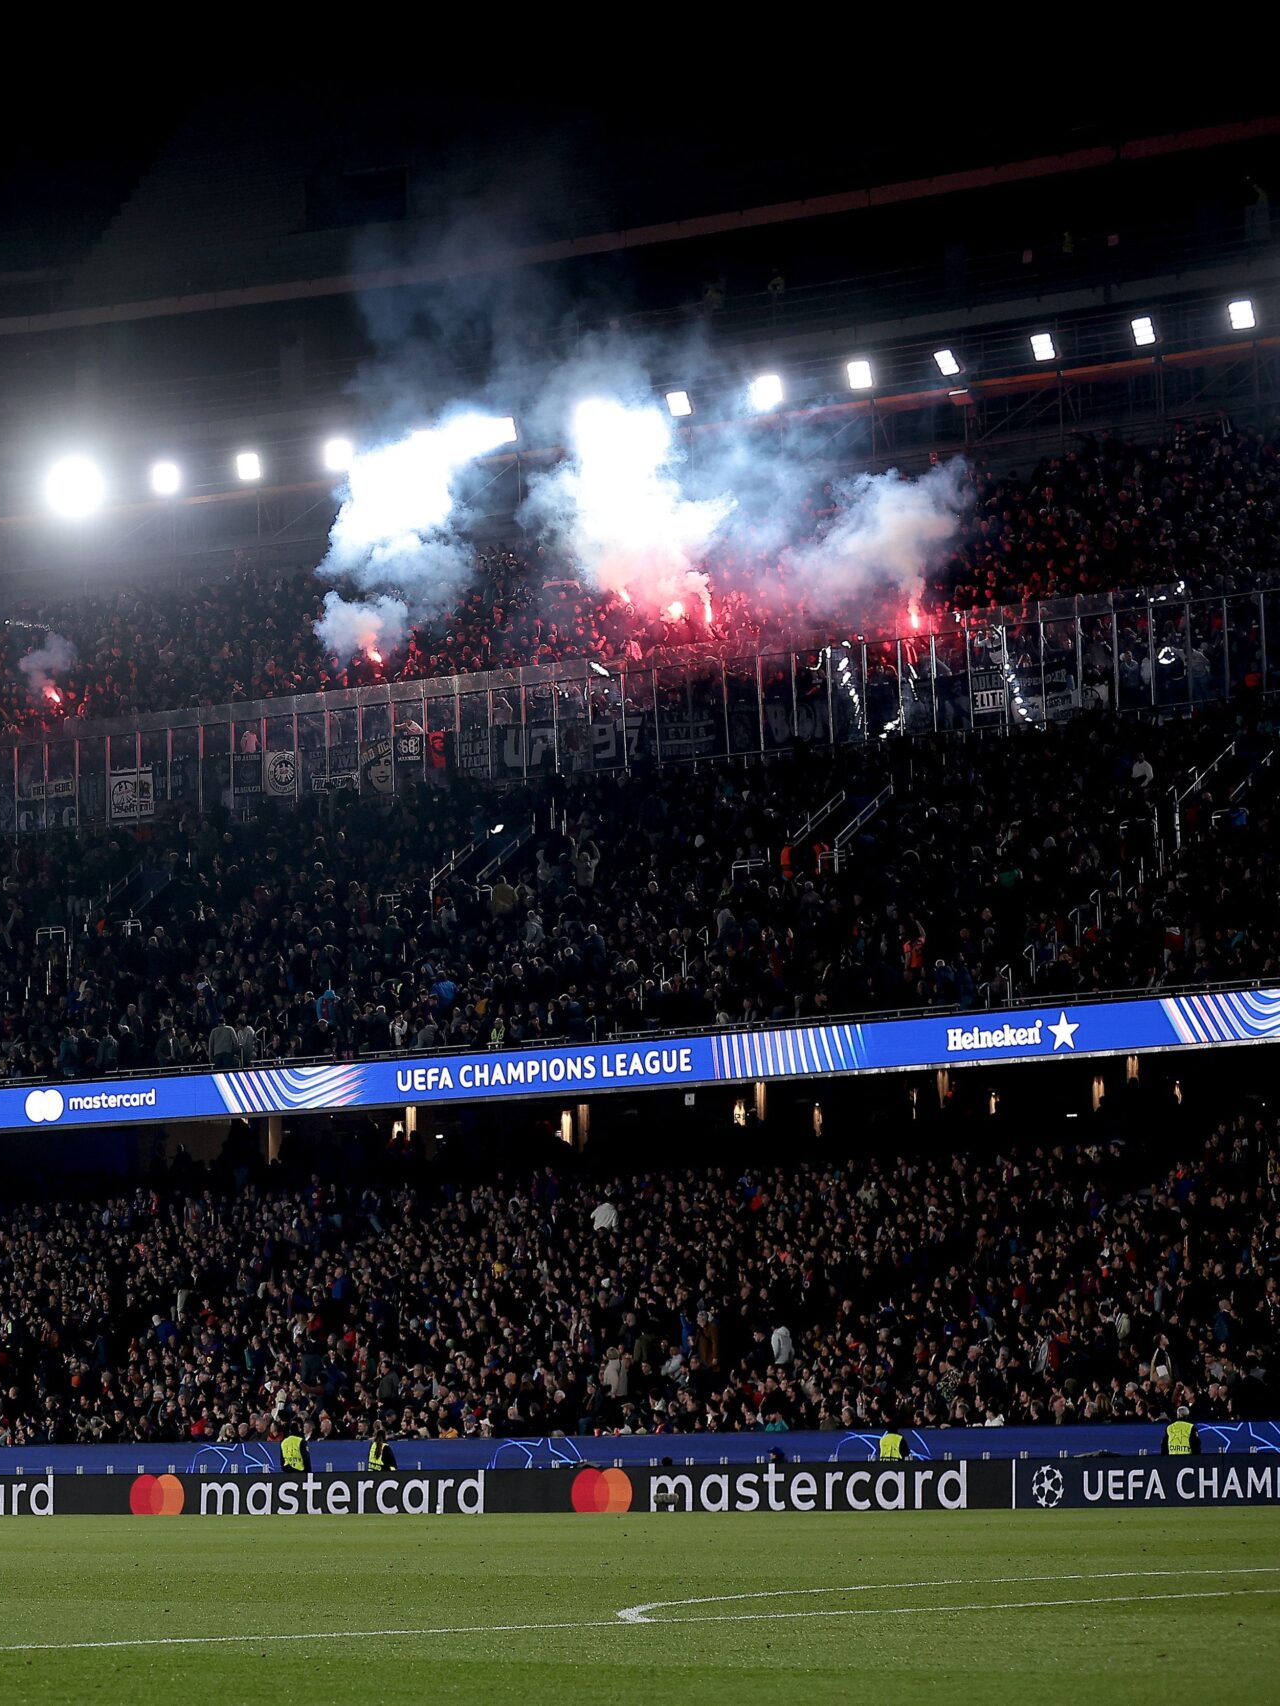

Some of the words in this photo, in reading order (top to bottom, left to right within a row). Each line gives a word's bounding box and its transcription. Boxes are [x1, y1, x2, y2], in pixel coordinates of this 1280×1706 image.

[401, 739, 415, 754] 68
[592, 715, 644, 759] 97
[947, 1021, 1042, 1051] Heineken
[396, 1067, 454, 1092] UEFA
[458, 1055, 596, 1088] CHAMPIONS
[601, 1048, 693, 1078] LEAGUE
[69, 1088, 157, 1110] mastercard
[200, 1470, 485, 1515] mastercard
[650, 1460, 967, 1513] mastercard
[1082, 1468, 1166, 1503] UEFA
[1176, 1465, 1280, 1500] CHAM
